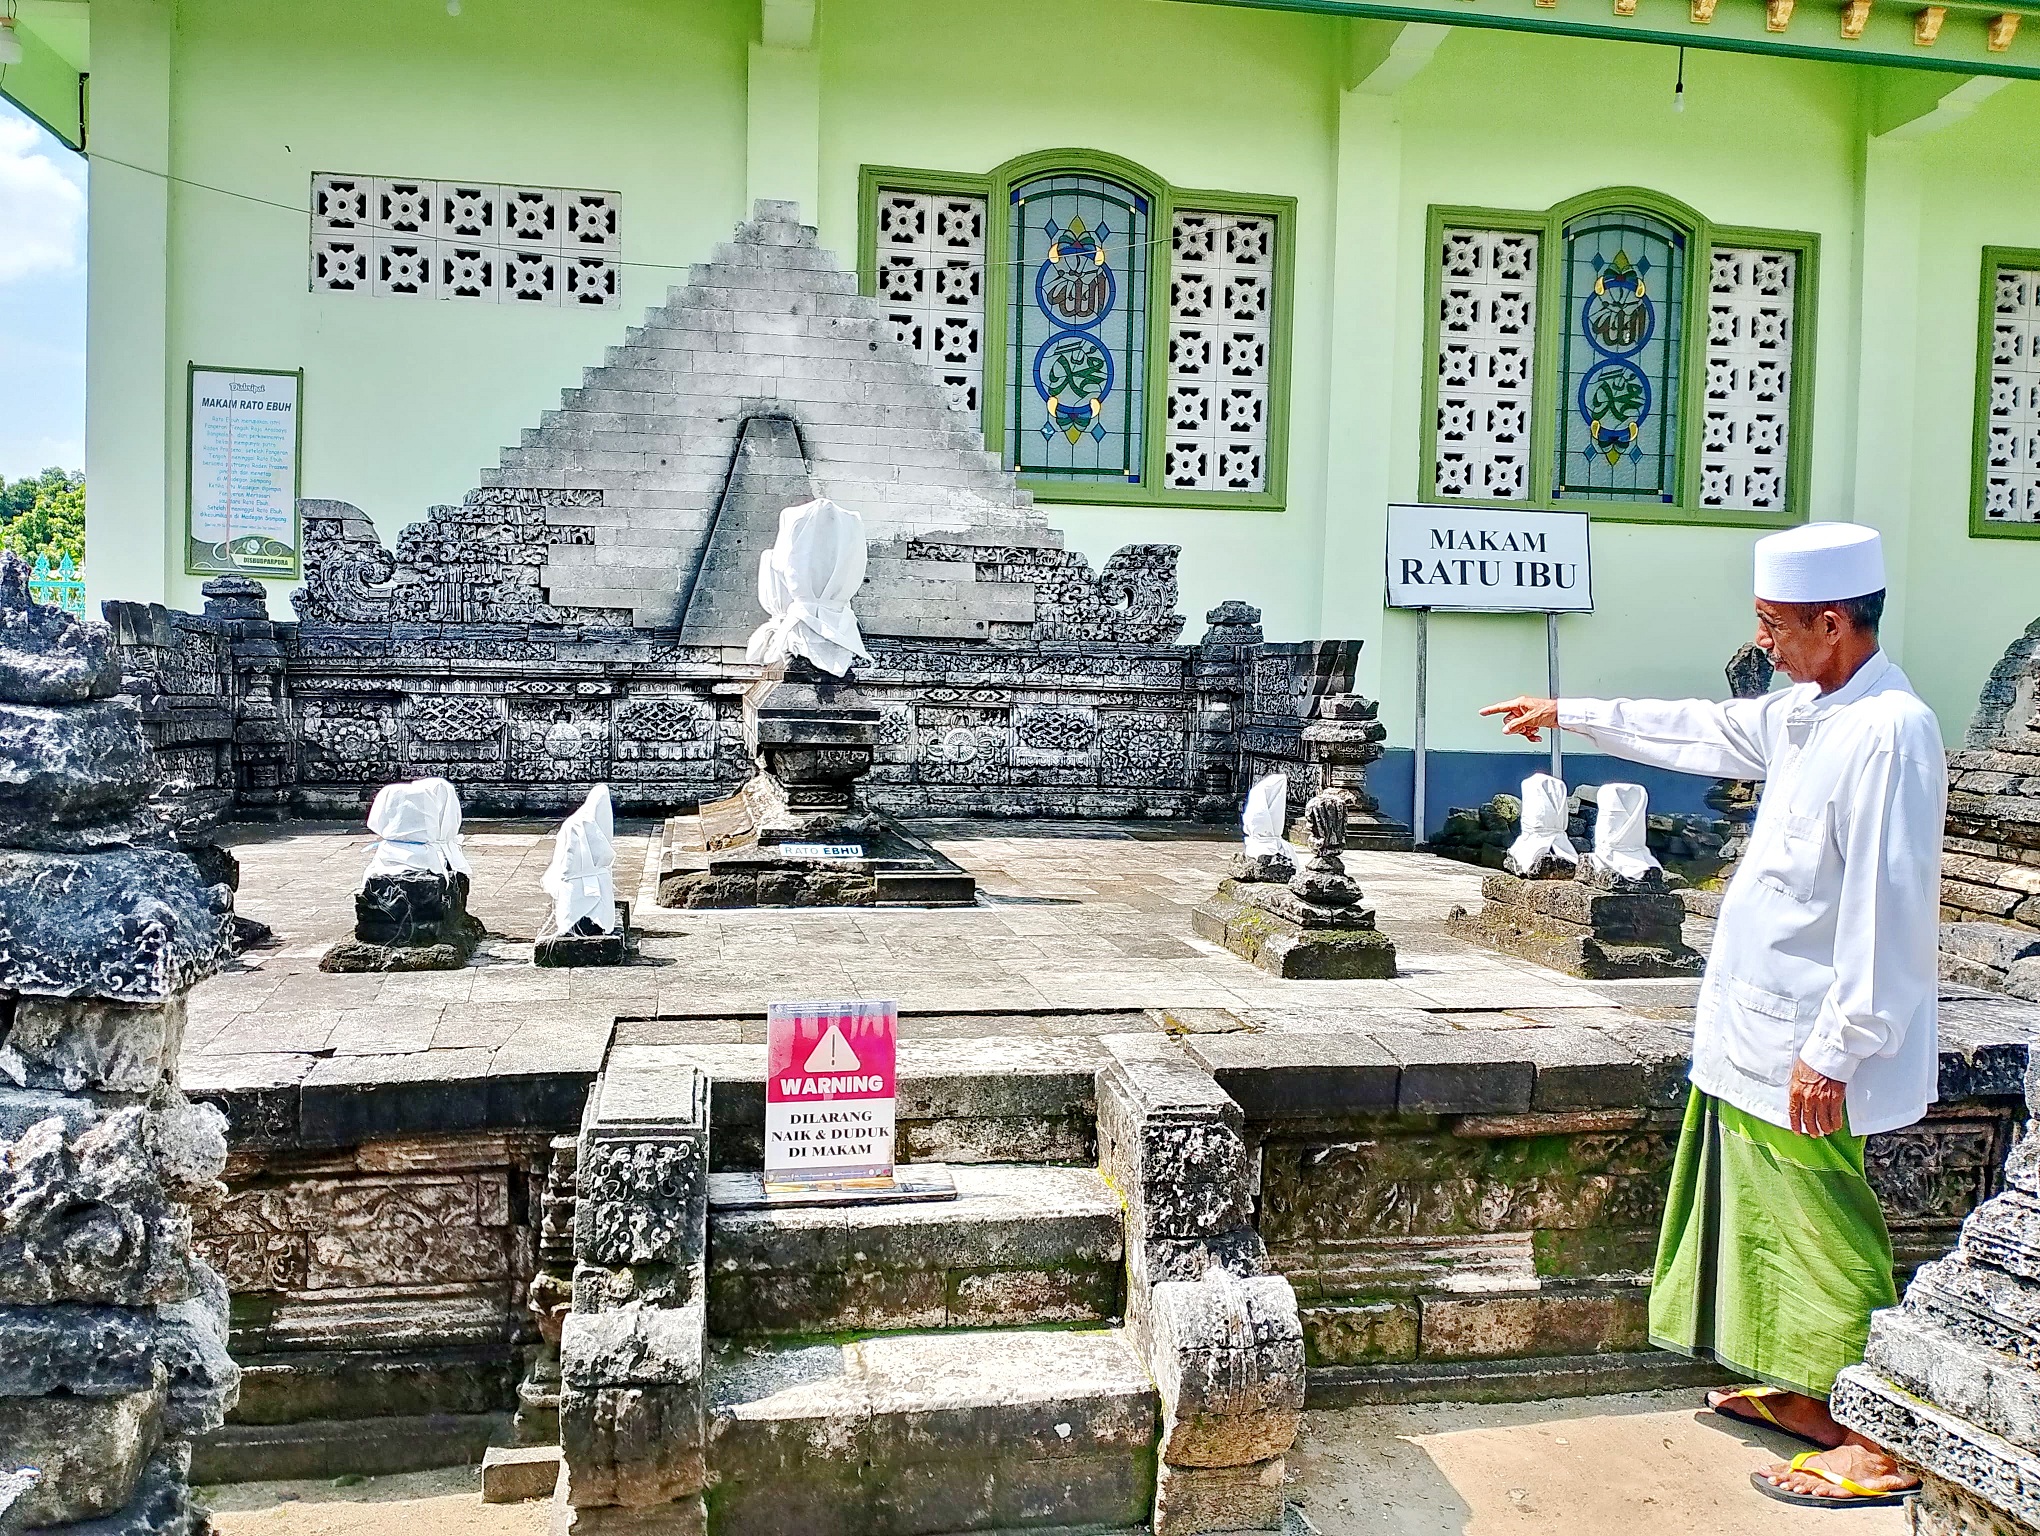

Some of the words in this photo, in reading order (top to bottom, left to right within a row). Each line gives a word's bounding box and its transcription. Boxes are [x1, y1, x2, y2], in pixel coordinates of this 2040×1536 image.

[202, 397, 237, 409] MAKAM
[240, 400, 264, 410] RATO
[266, 402, 292, 412] EBUH
[1429, 528, 1548, 553] MAKAM
[1399, 558, 1503, 587] RATU
[1514, 561, 1579, 589] IBU
[785, 847, 818, 855] RATO
[823, 847, 859, 855] EBHU
[780, 1075, 884, 1096] WARNING
[791, 1111, 873, 1125] DILARANG
[771, 1130, 812, 1142] NAIK
[816, 1129, 827, 1140] &
[831, 1127, 889, 1139] DUDUK
[789, 1147, 807, 1158] DI
[812, 1144, 872, 1157] MAKAM
